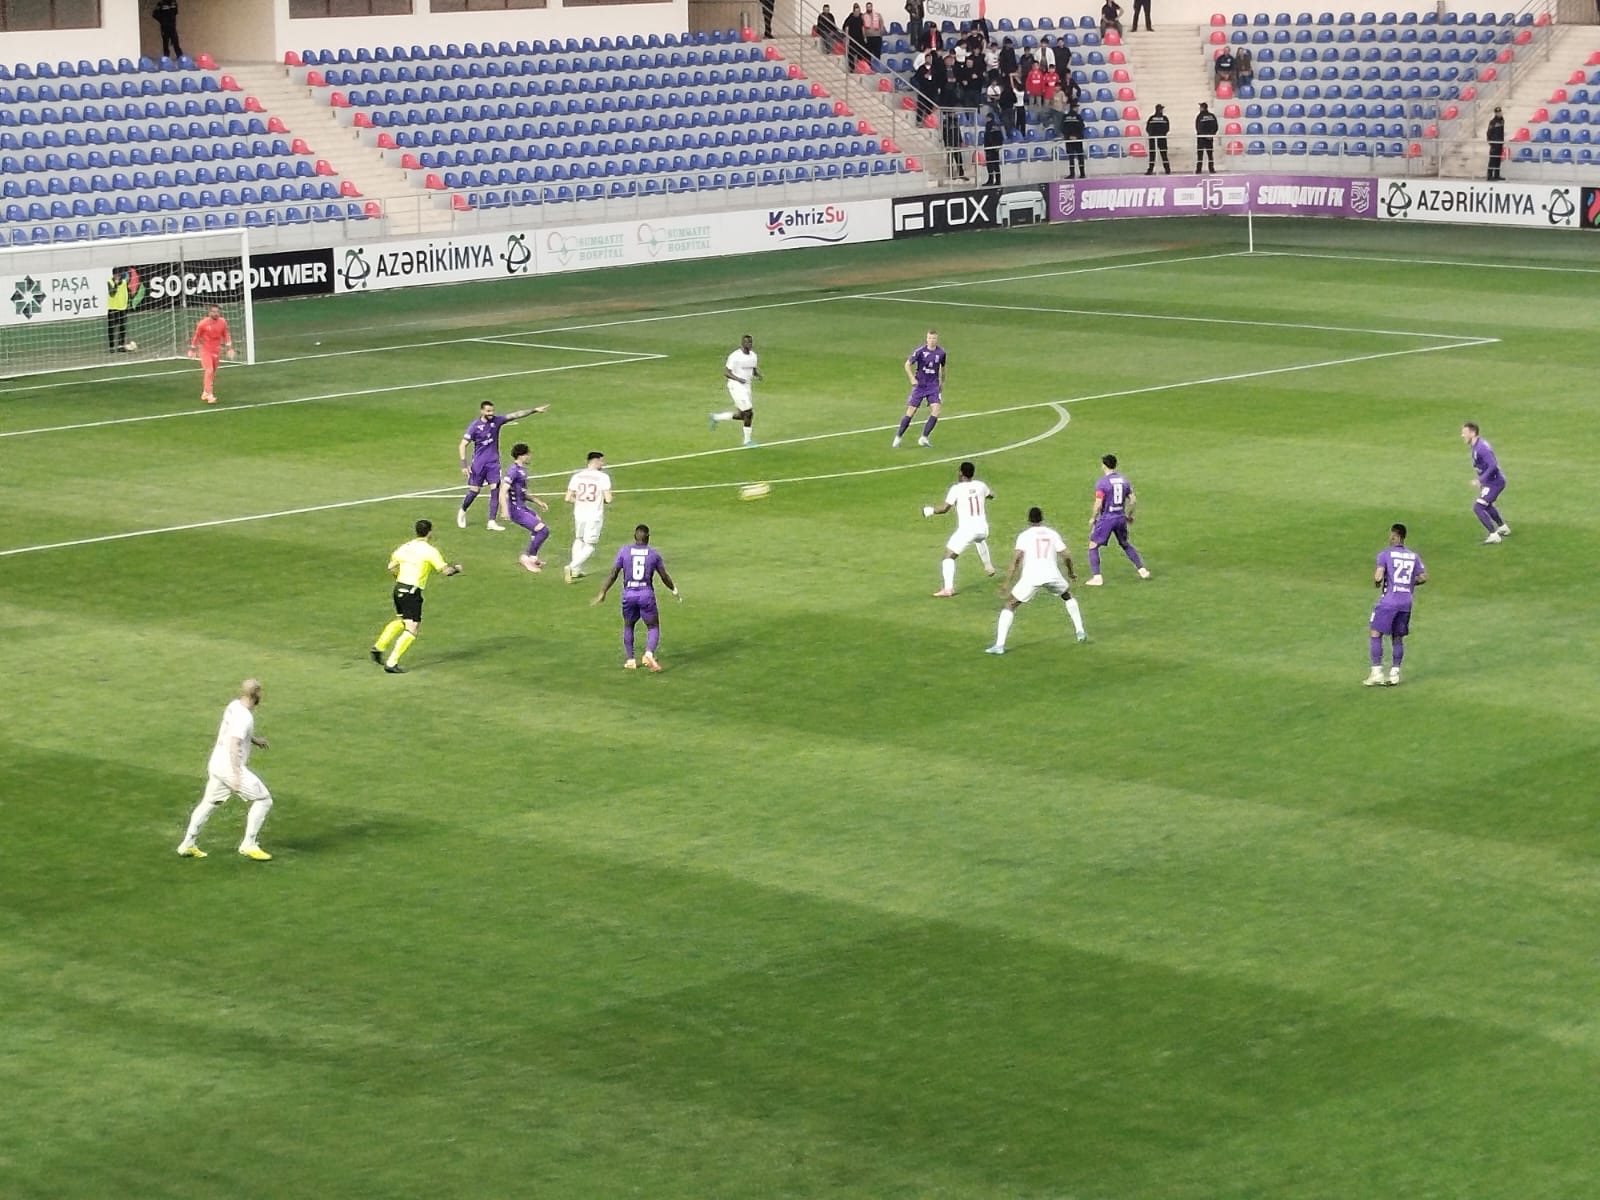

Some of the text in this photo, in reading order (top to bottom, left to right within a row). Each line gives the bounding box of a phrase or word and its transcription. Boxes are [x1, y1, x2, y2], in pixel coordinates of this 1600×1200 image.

[1146, 187, 1166, 207] FK
[1197, 179, 1224, 210] 15
[1327, 187, 1345, 207] FK
[1416, 186, 1535, 216] AZƏRİKİMYA
[375, 241, 494, 278] AZƏRİKİMYA
[51, 276, 90, 294] PAŞA
[52, 295, 99, 315] Həyat
[577, 482, 598, 502] 23
[968, 496, 981, 516] 11
[1035, 538, 1051, 559] 17
[631, 555, 646, 581] 6
[1392, 559, 1415, 585] 23
